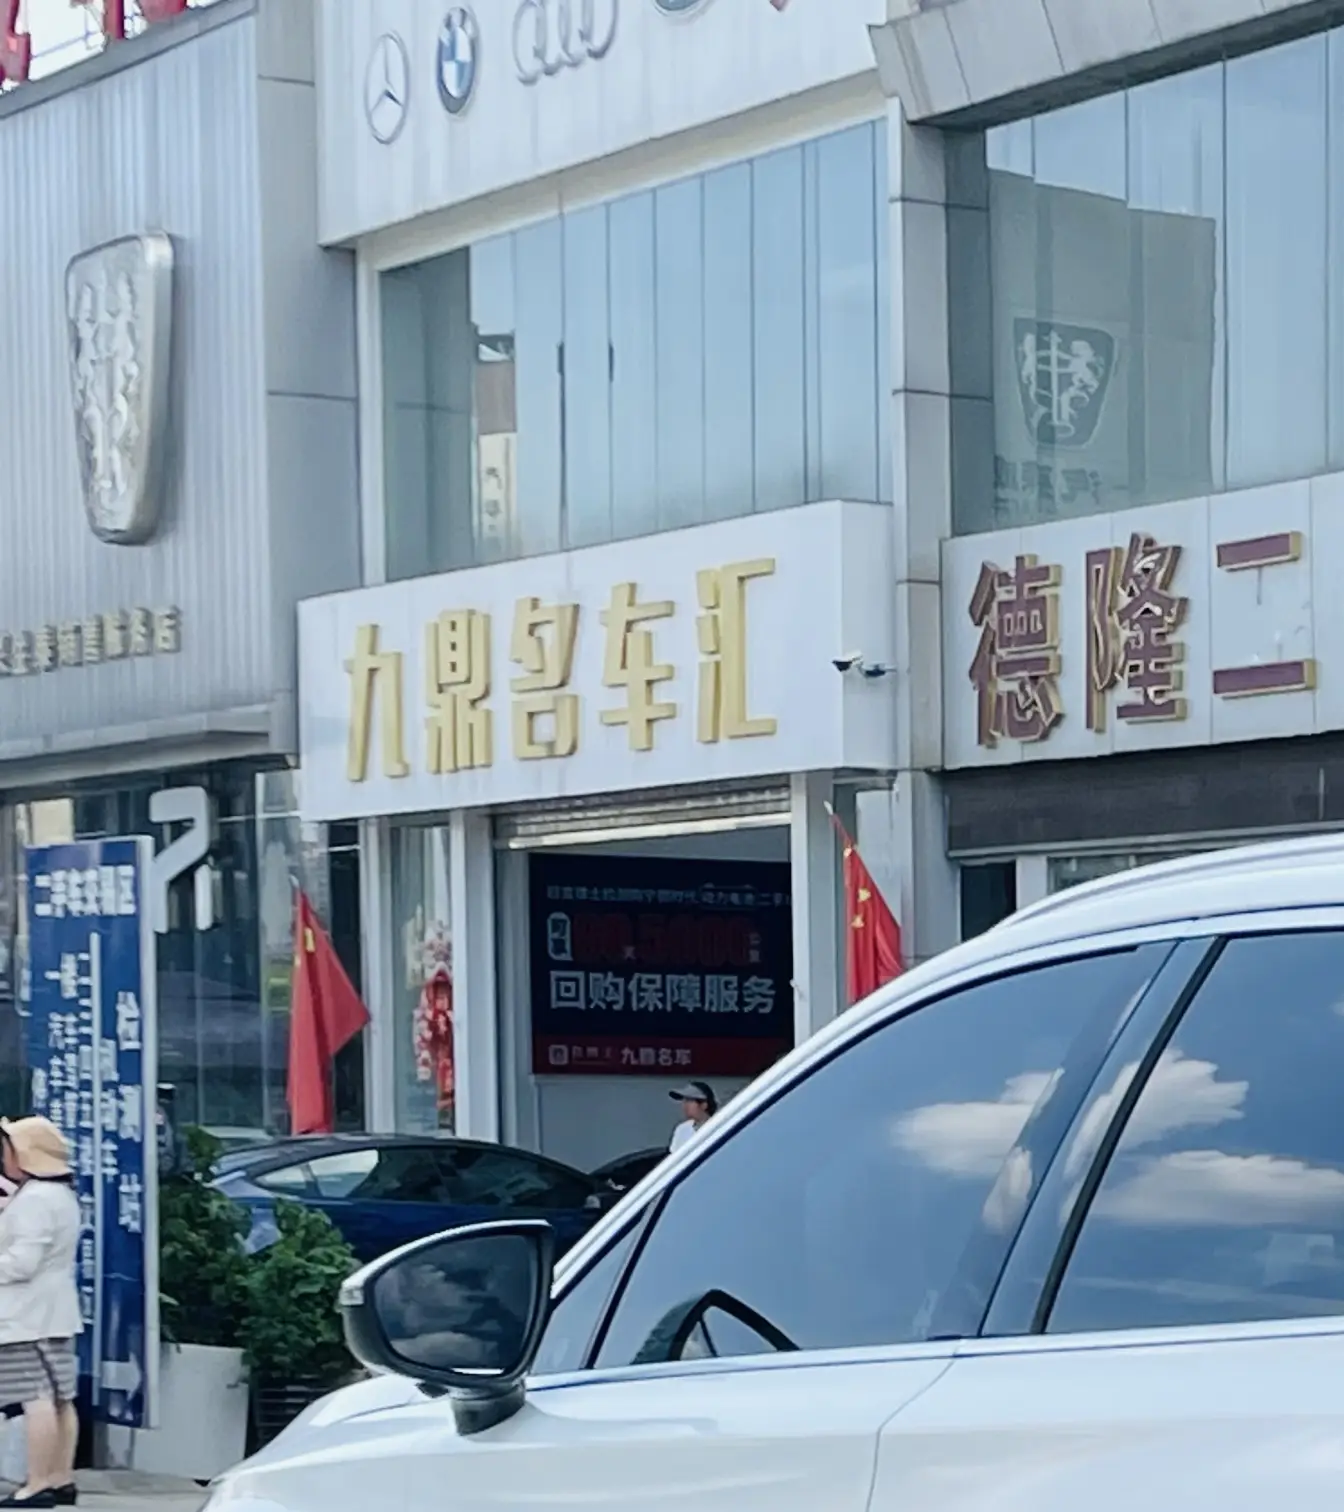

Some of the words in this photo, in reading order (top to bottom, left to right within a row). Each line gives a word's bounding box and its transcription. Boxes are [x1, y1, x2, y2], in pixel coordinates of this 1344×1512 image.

[343, 557, 777, 782] 九鼎名车汇
[549, 970, 777, 1014] 回购保障服务
